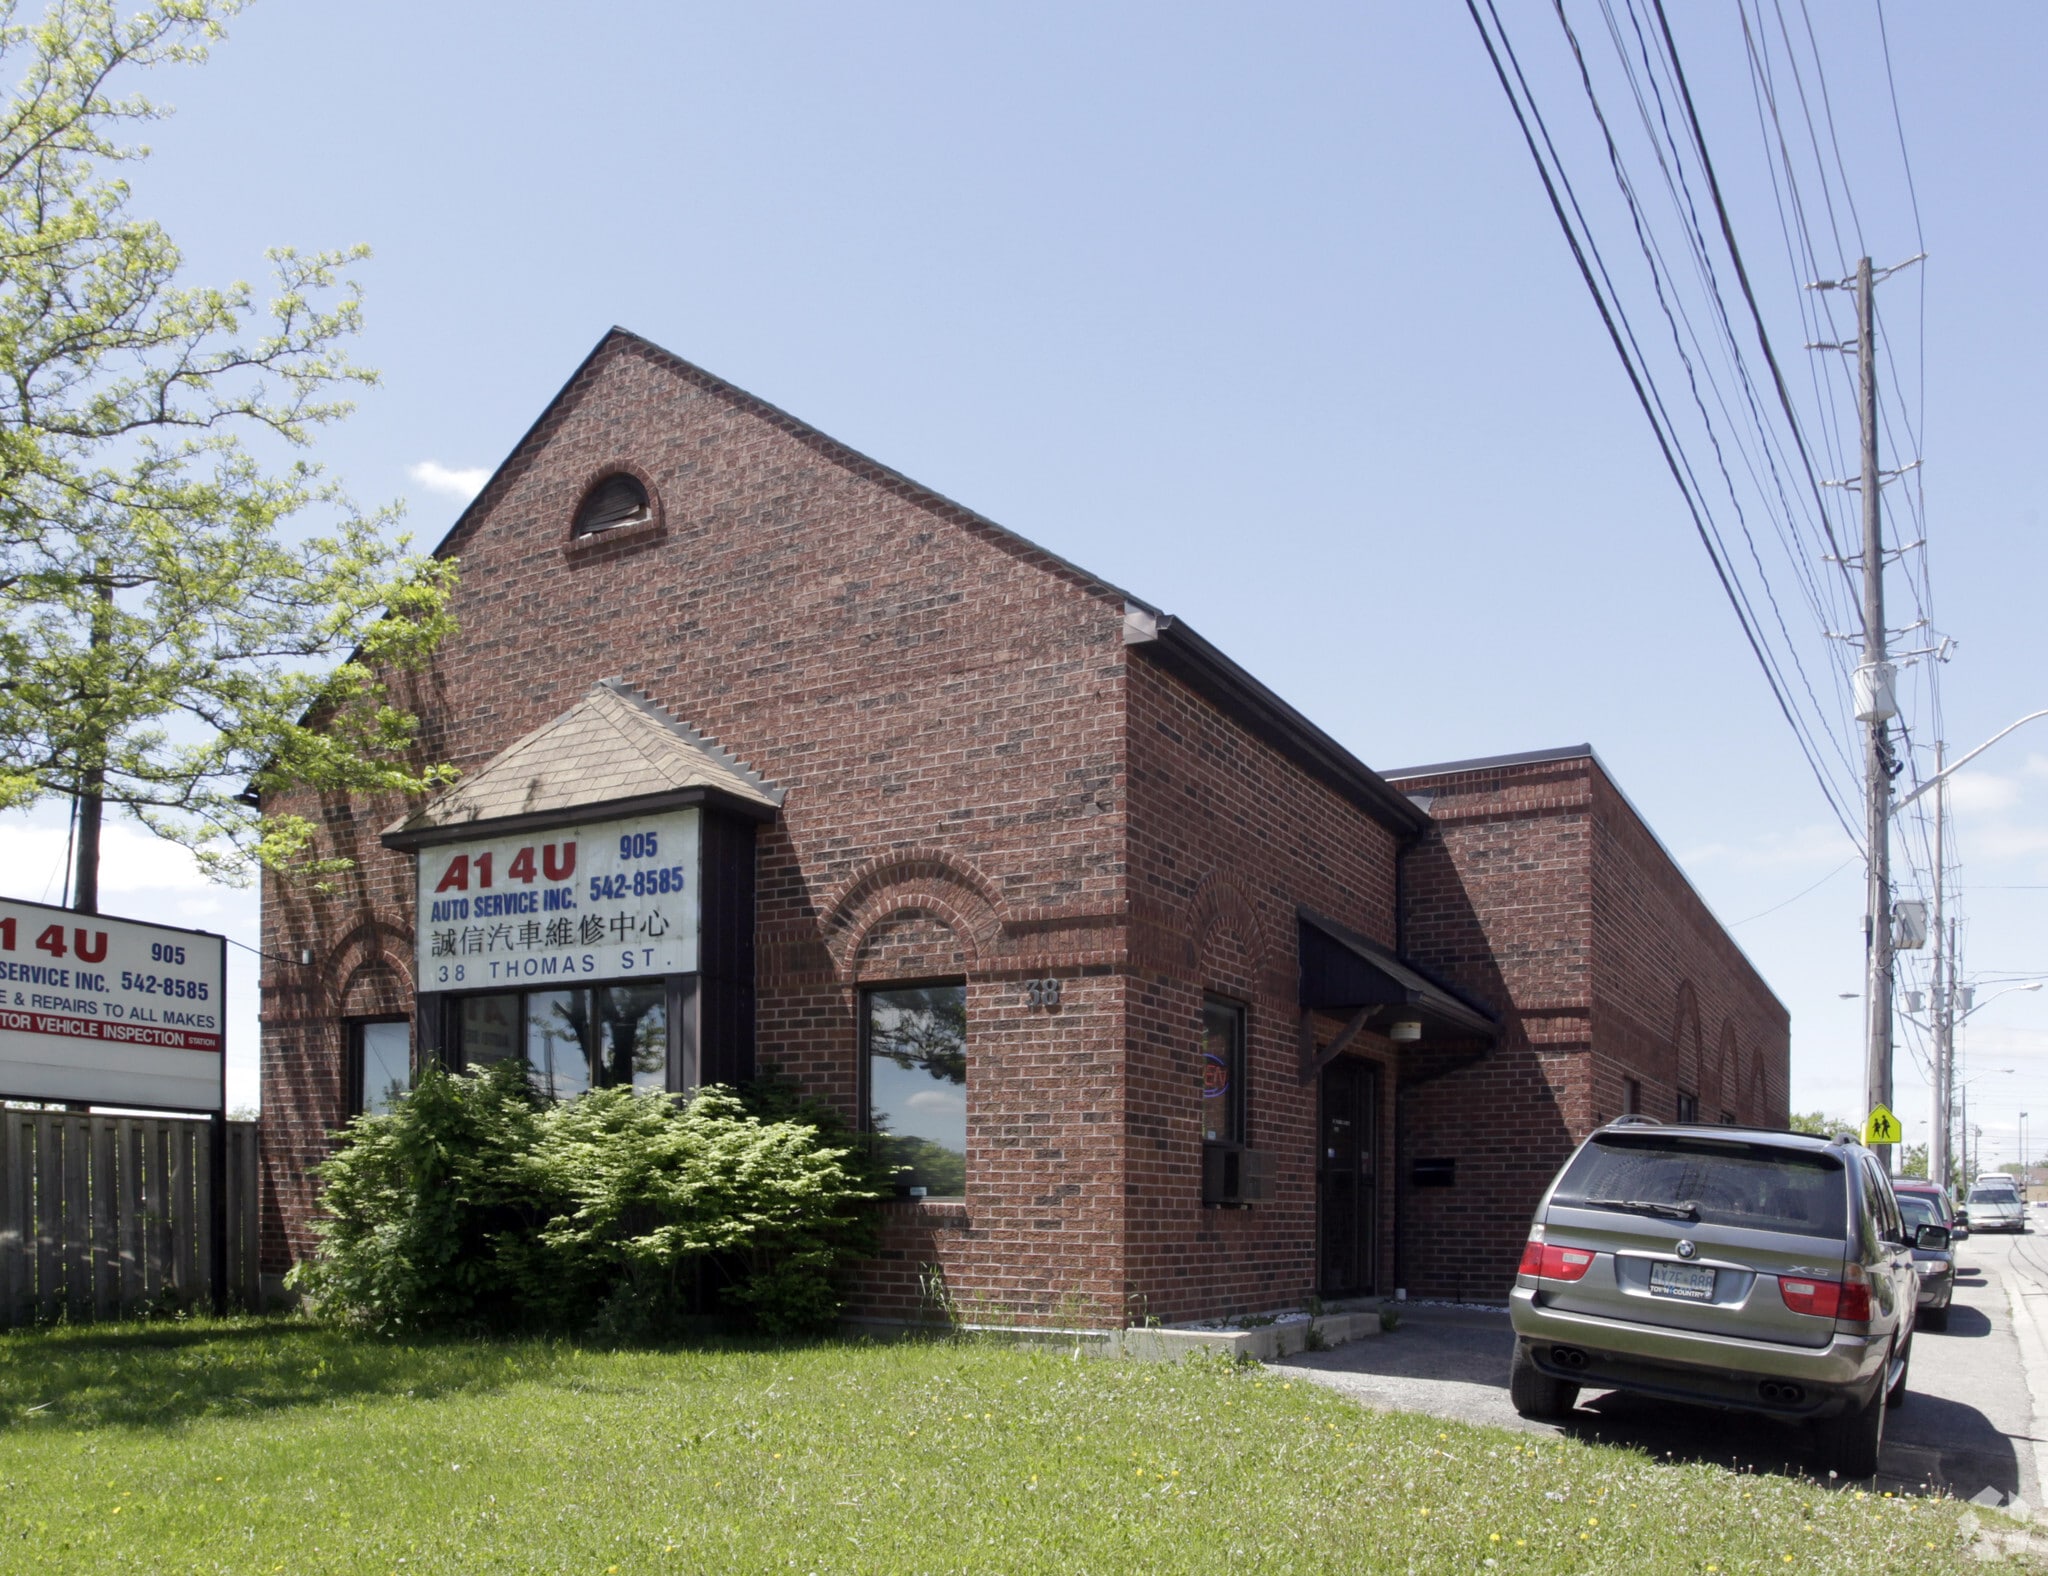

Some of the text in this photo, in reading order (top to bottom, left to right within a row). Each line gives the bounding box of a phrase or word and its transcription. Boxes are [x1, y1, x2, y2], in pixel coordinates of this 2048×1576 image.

[620, 831, 658, 860] 905
[590, 866, 684, 901] 542-8585
[431, 887, 577, 923] AUTO SERVICE INC.
[431, 909, 670, 958] 誠信汽車維修中心
[151, 942, 186, 966] 905
[438, 948, 672, 983] 38 THOMAS ST.
[0, 961, 110, 993] SERVICE INC.
[121, 971, 209, 1001] 542-8585
[1025, 977, 1059, 1006] 38
[14, 992, 25, 1006] &
[31, 993, 98, 1015] REPAIRS
[103, 1003, 124, 1018] TO
[130, 1007, 158, 1023] ALL
[163, 1011, 215, 1029] MAKES
[36, 1016, 99, 1037] VEHICLE
[103, 1024, 185, 1047] INSPECTION
[188, 1037, 216, 1047] STATION
[1787, 1265, 1829, 1276] X5
